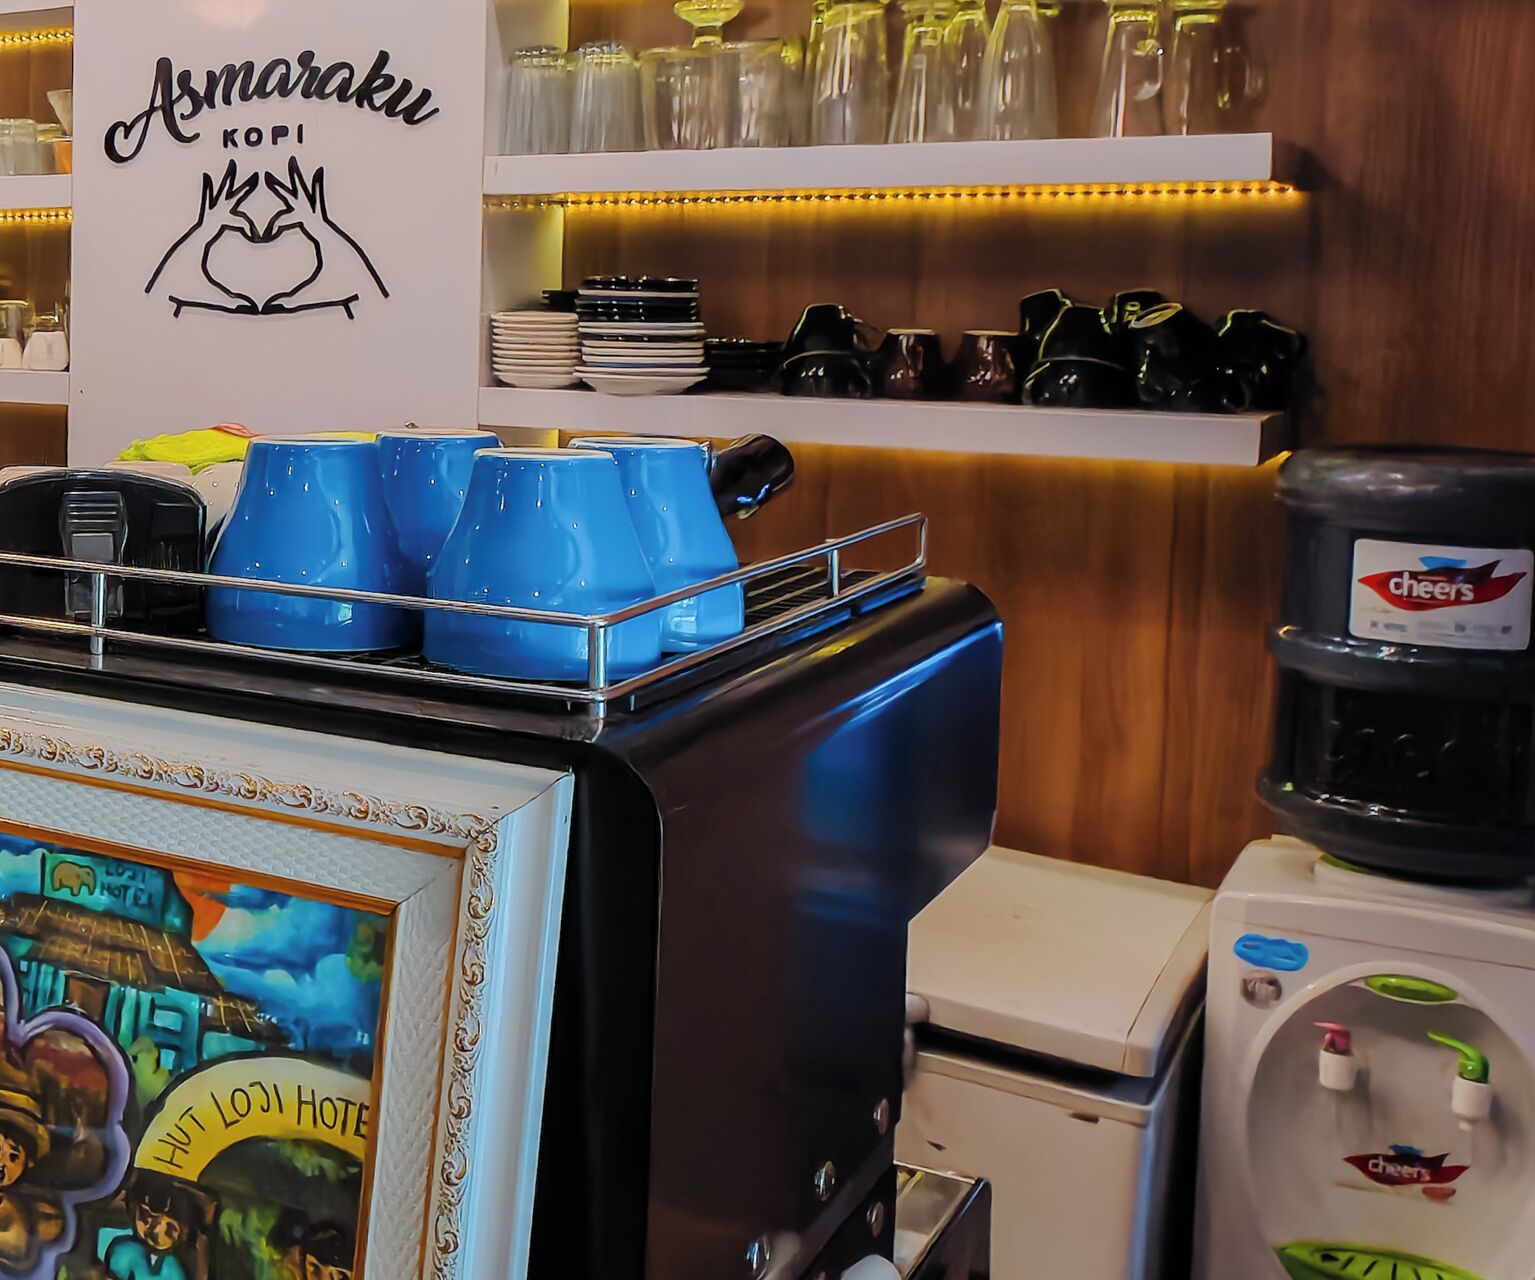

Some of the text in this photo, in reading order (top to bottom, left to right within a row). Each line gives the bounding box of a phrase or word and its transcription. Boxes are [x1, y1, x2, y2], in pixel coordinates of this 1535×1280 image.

[104, 50, 440, 164] Asmaraku
[223, 124, 304, 149] KOPI
[1388, 571, 1475, 602] cheers
[153, 1106, 207, 1170] HUT
[211, 1080, 284, 1130] LOJI
